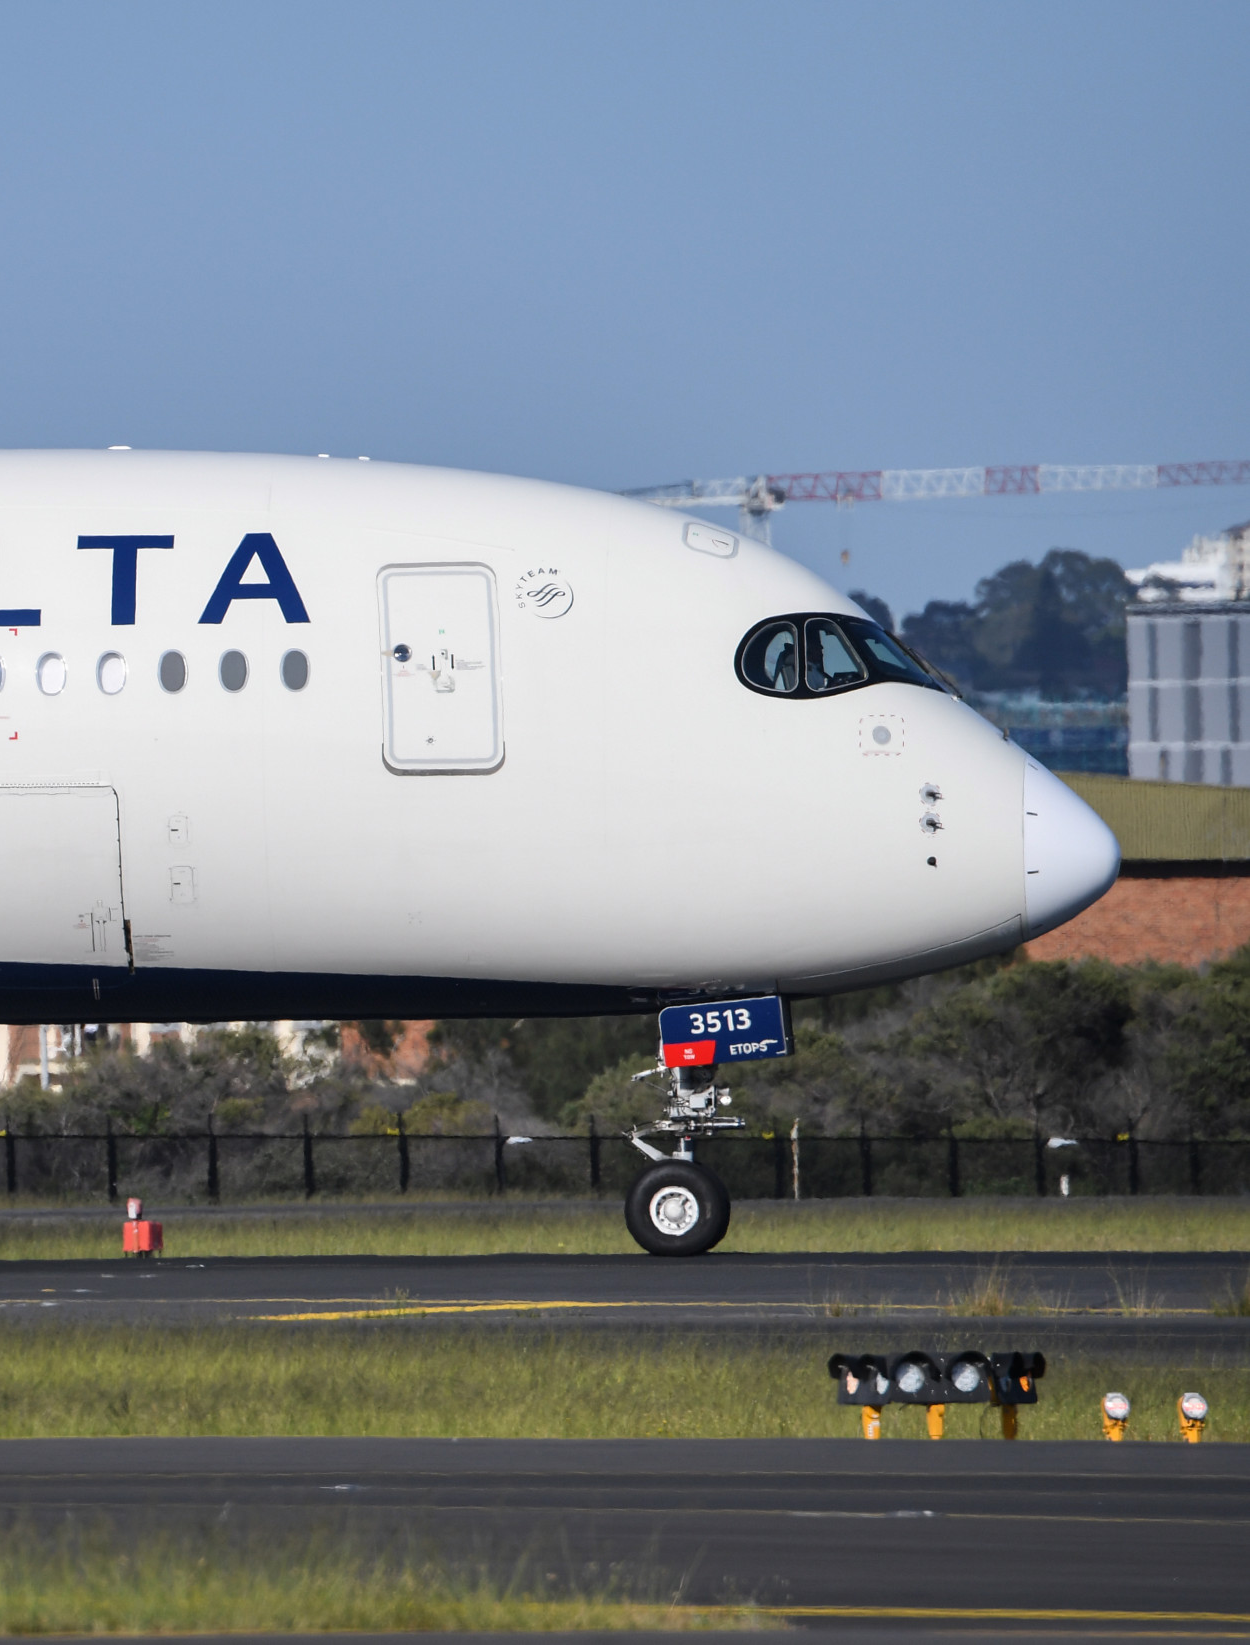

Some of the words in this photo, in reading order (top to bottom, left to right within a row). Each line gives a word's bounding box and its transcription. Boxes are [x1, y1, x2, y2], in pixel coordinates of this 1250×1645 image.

[515, 567, 558, 609] SKYTEAM
[689, 1008, 752, 1034] 3513
[729, 1042, 769, 1056] ETOPS
